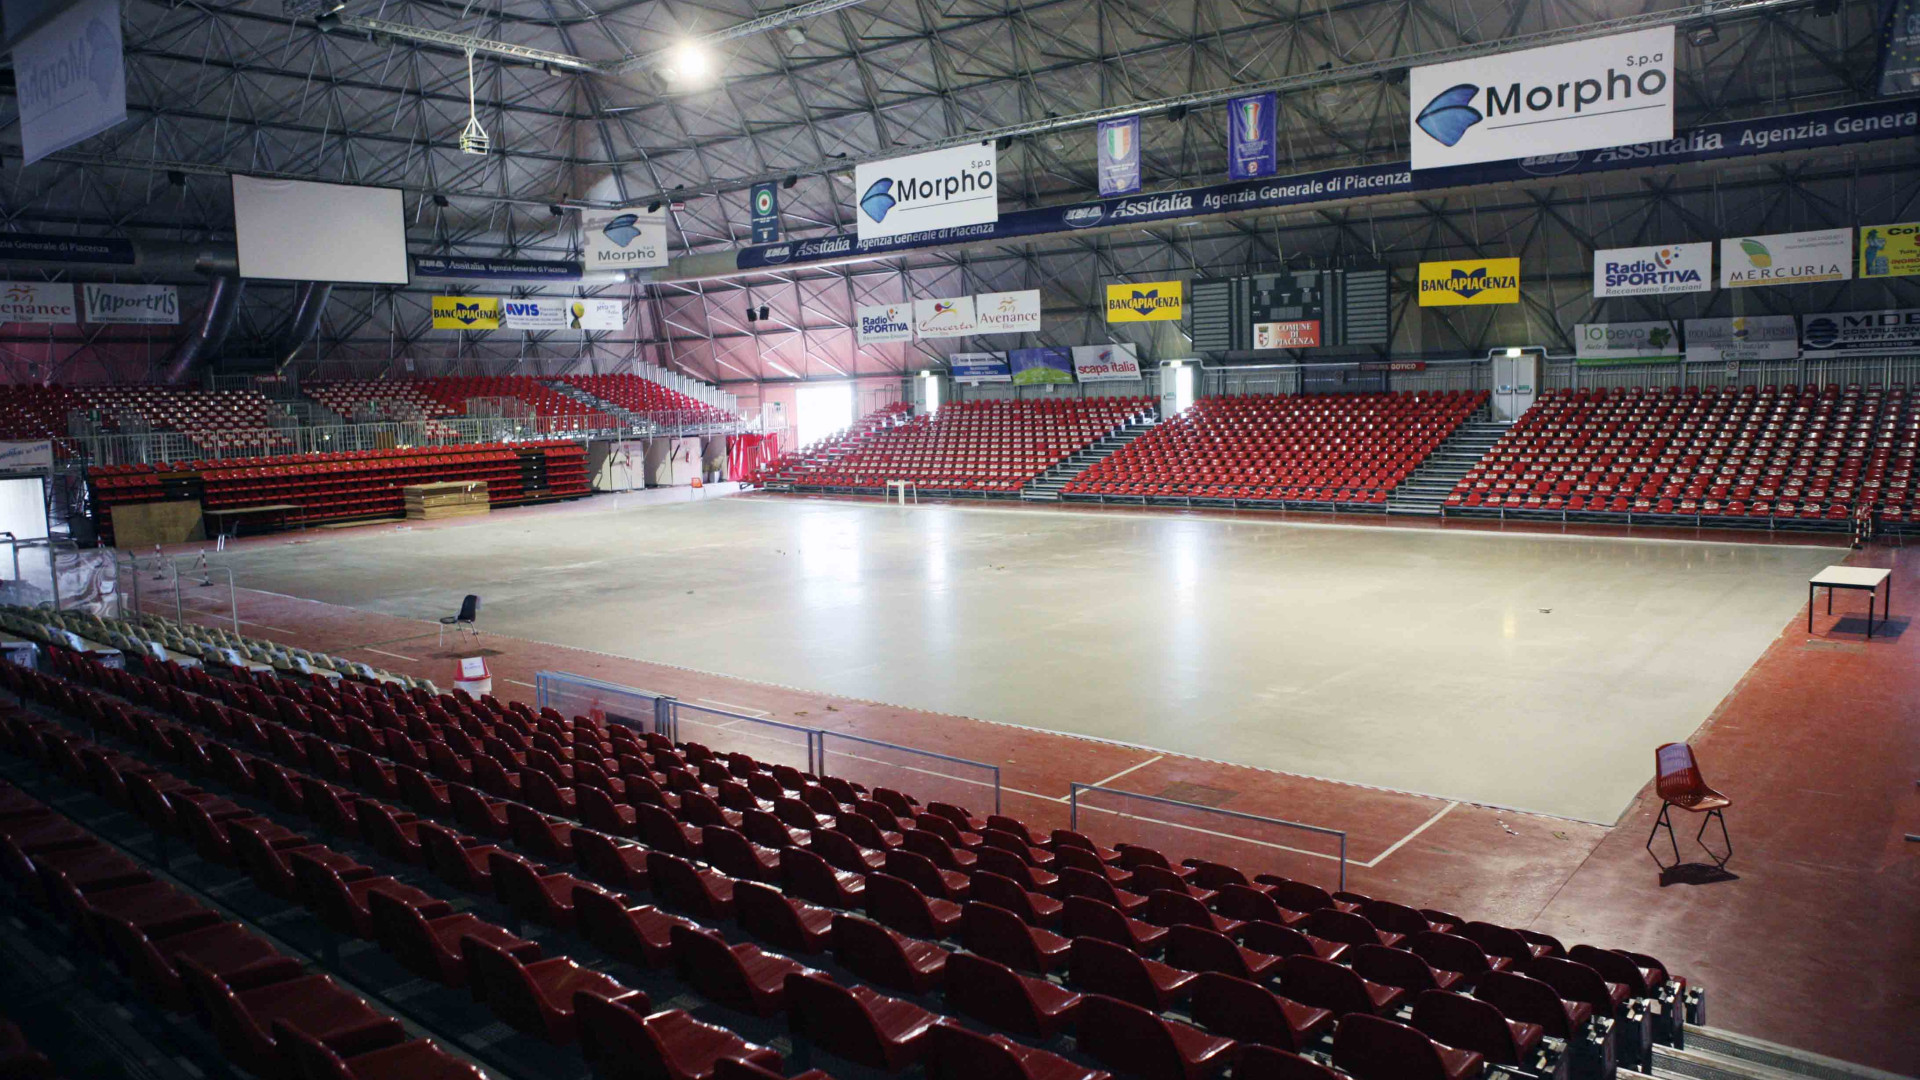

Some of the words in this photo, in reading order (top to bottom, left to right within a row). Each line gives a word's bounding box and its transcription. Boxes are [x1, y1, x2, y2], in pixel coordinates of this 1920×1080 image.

[1626, 52, 1663, 67] S.p.a
[1486, 68, 1666, 117] Morpho
[1592, 129, 1724, 163] Assitalia
[1740, 121, 1828, 148] Agenzia
[1834, 111, 1918, 134] Genera
[897, 169, 993, 202] Morpho
[1110, 193, 1193, 218] Assitalia
[1202, 189, 1256, 209] Agenzia
[1260, 180, 1323, 200] Generale
[1326, 177, 1341, 192] di
[1344, 171, 1411, 190] Piacenza
[14, 240, 57, 251] Generale
[59, 243, 68, 251] di
[69, 243, 109, 253] Piacenza
[795, 236, 851, 257] Assitalia
[856, 237, 892, 251] Agenzia
[894, 230, 936, 244] Generale
[938, 228, 948, 238] di
[950, 223, 994, 237] Piacenza
[598, 249, 656, 261] Morpho
[448, 261, 486, 271] Assitalia
[1605, 260, 1656, 275] Radio
[1730, 264, 1840, 280] MERCURIA
[1605, 269, 1702, 287] SPORTIVA
[86, 285, 176, 315] Vaportris
[0, 303, 71, 315] enance
[506, 303, 540, 316] AVIS
[863, 315, 888, 325] Radio
[980, 312, 1037, 323] Avenance
[863, 323, 909, 334] SPORTIVA
[1278, 323, 1313, 331] COMUNE
[1275, 337, 1314, 346] PIACENZA
[1078, 364, 1109, 376] scapa
[1111, 361, 1136, 372] italia
